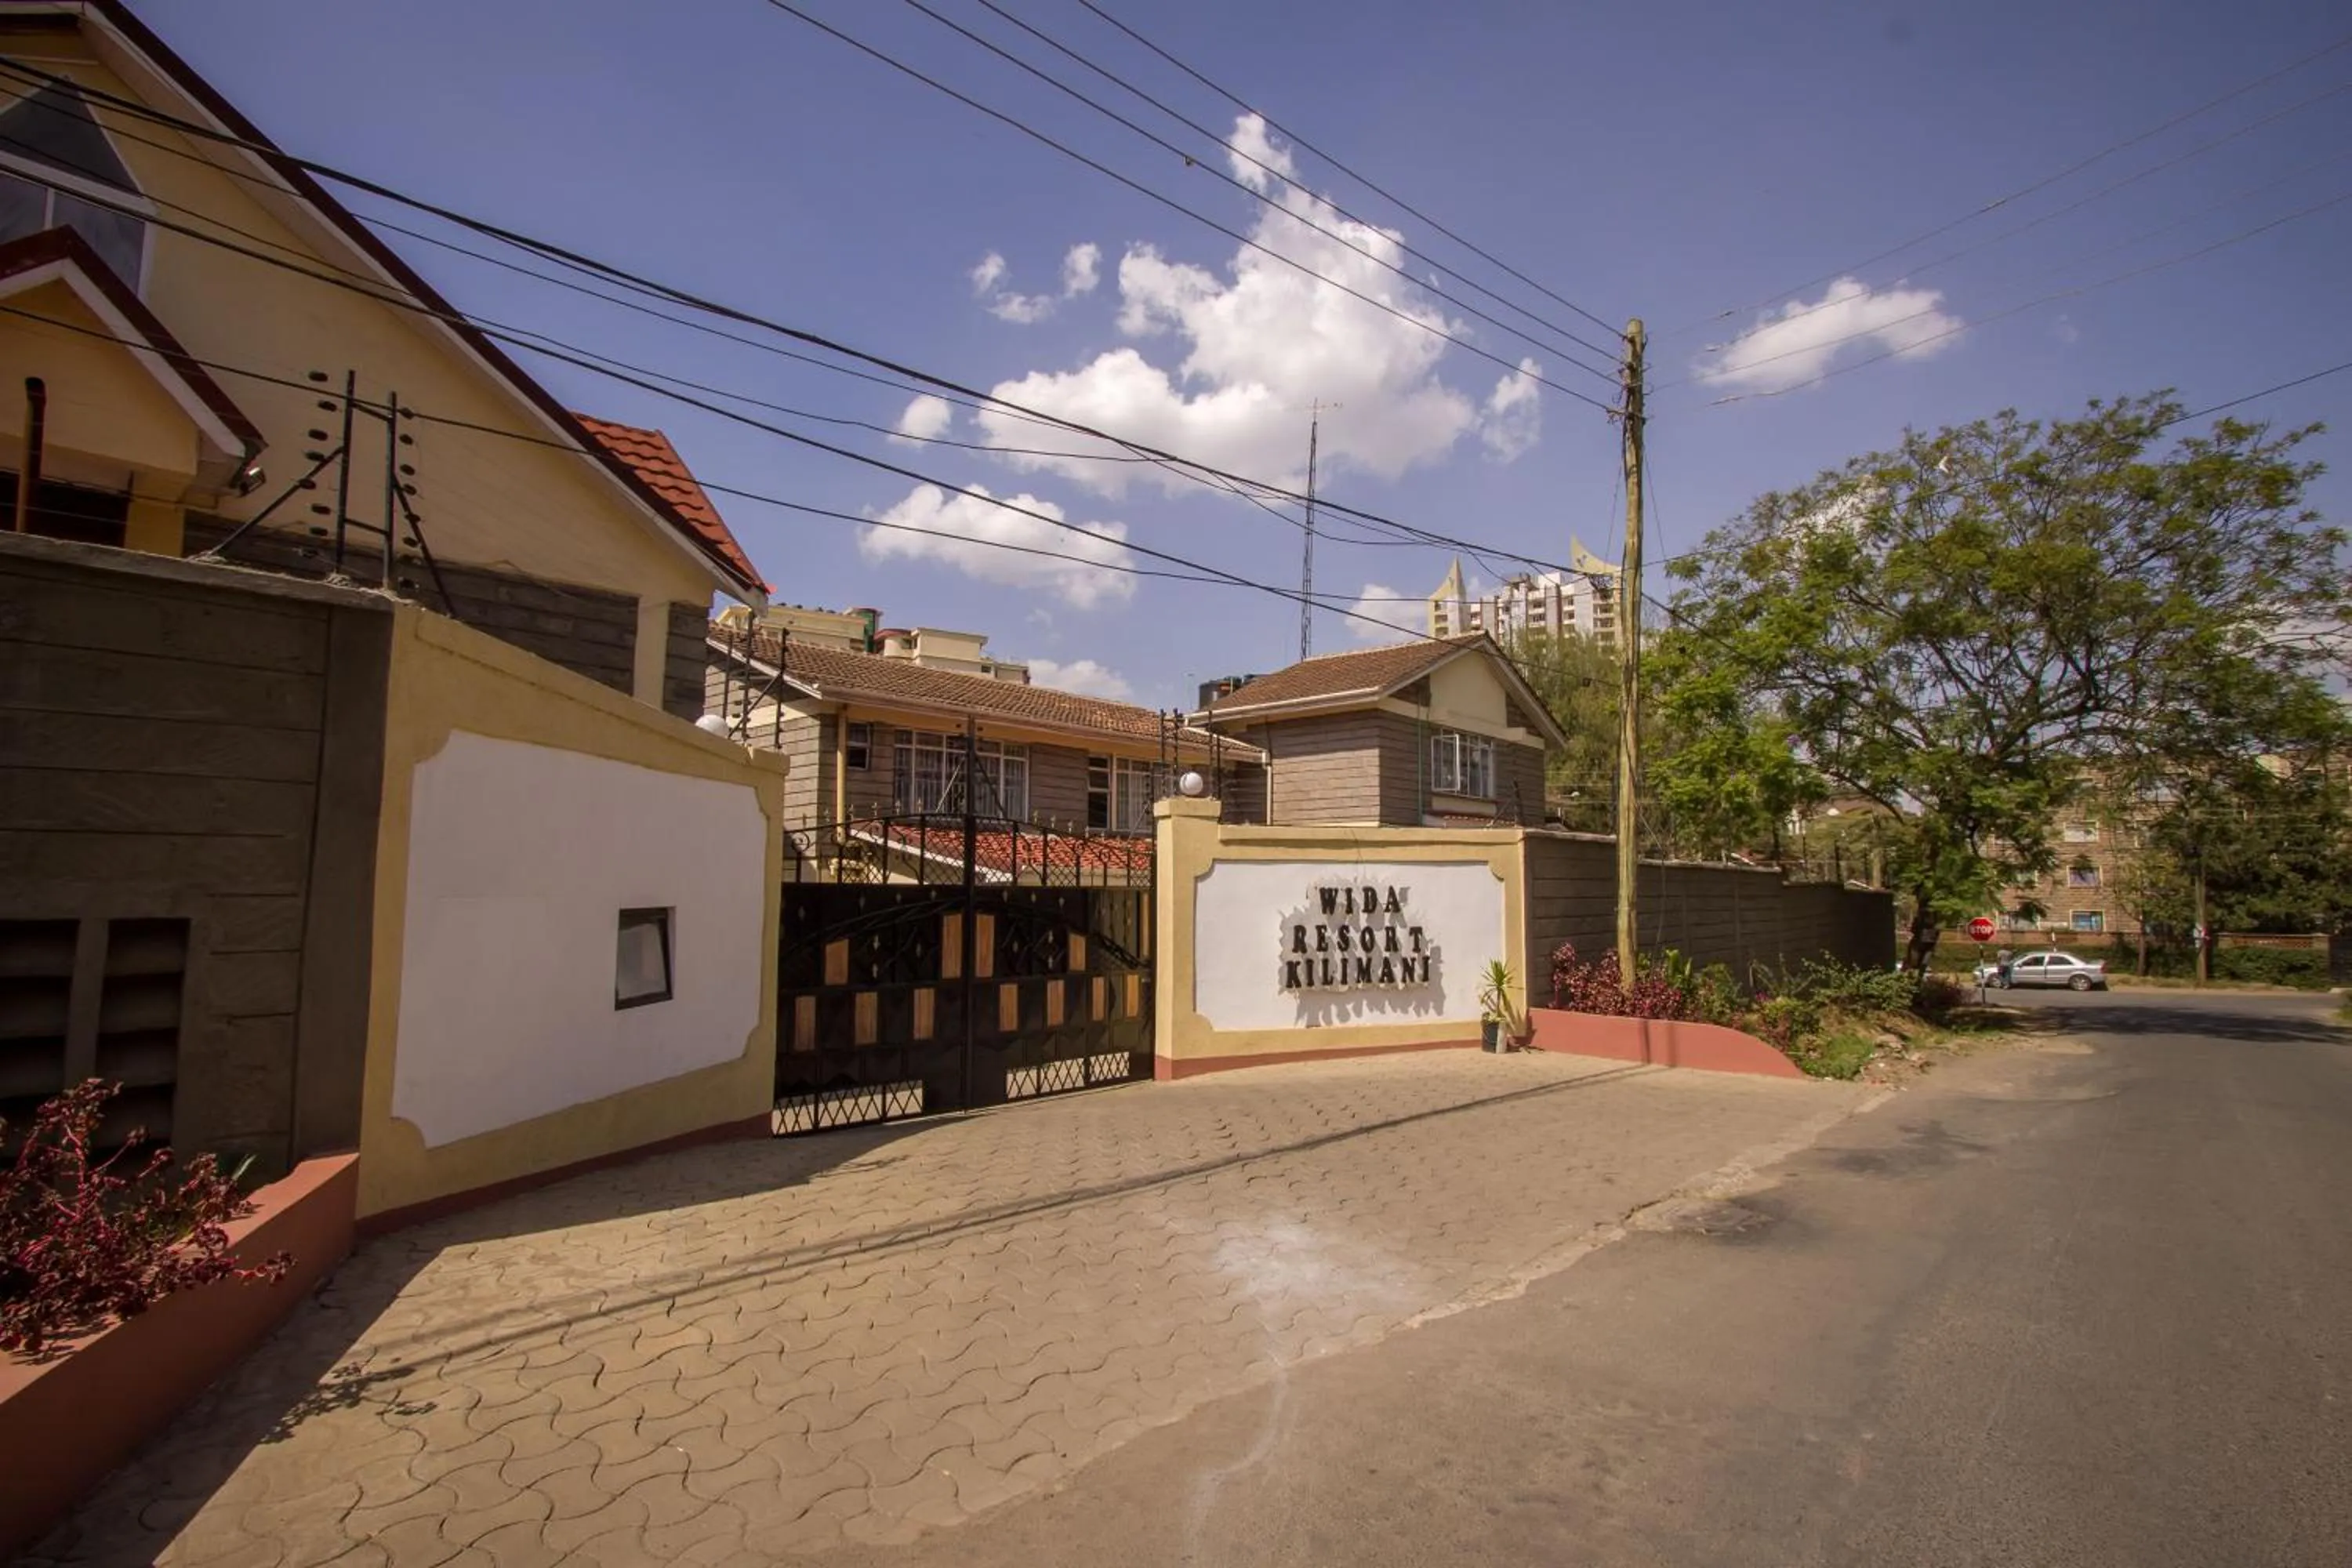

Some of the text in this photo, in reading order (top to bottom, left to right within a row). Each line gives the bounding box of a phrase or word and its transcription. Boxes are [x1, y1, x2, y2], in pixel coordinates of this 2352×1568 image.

[1319, 885, 1401, 915] WIDA
[1292, 924, 1424, 953] RESORT
[1969, 925, 1993, 935] STOP
[1286, 956, 1431, 989] KILIMANI
